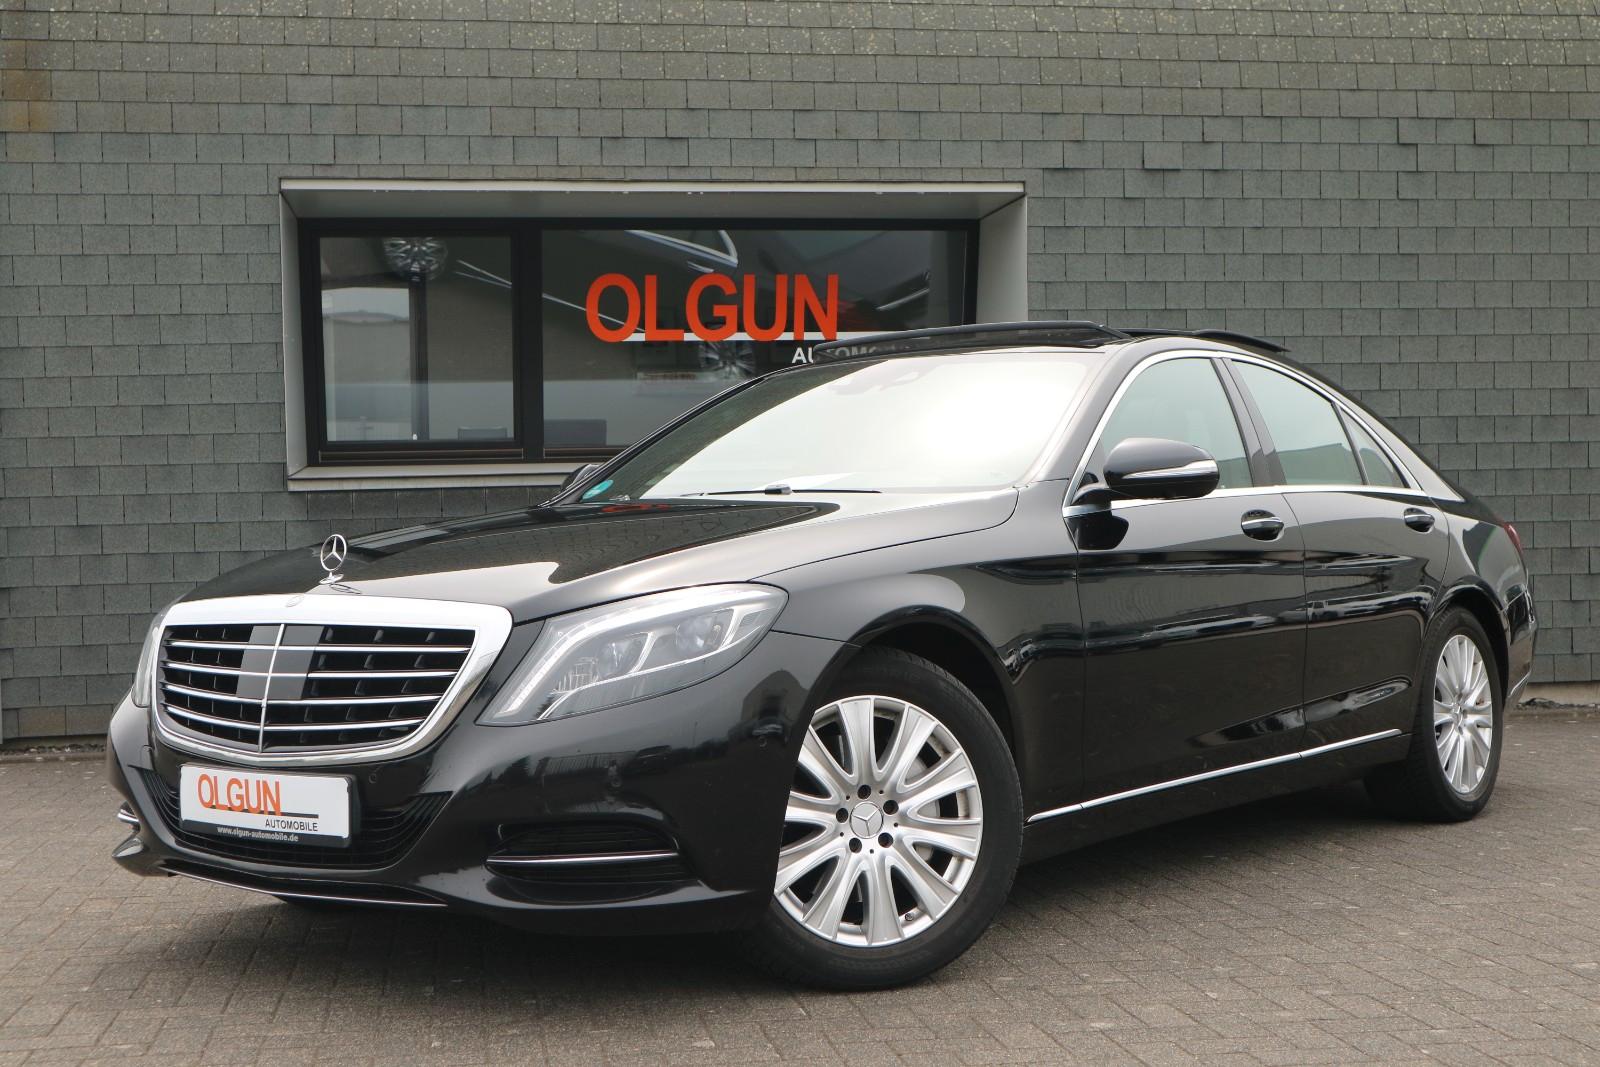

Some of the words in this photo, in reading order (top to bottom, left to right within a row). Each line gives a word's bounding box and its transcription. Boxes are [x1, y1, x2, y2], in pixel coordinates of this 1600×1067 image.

[586, 273, 838, 342] OLGUN
[198, 774, 283, 816] OLGUN
[217, 826, 299, 842] www.olgun-automobile.de
[265, 819, 319, 832] AUTOMOBILE
